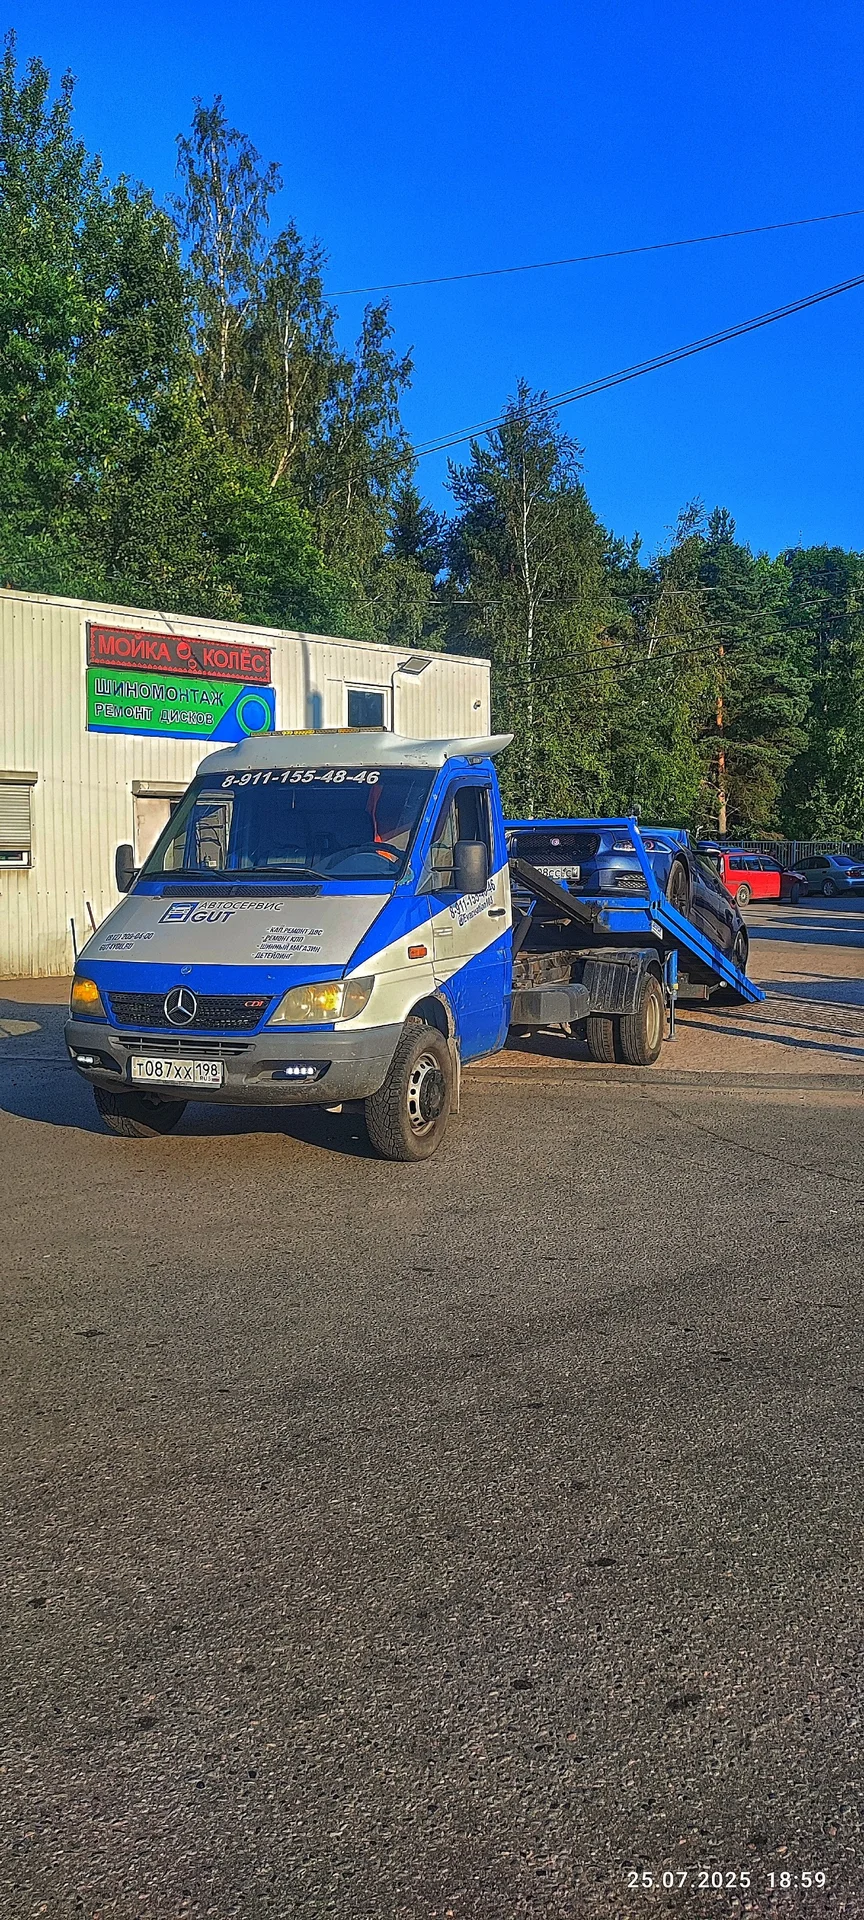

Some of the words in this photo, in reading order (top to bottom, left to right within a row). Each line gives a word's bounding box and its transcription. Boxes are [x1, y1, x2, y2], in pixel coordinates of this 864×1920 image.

[99, 634, 171, 662] МОЙКА
[203, 648, 265, 673] КОЛЁС
[94, 678, 224, 706] ШИНОМОНТАЖ
[94, 703, 153, 721] РЕМОНТ
[160, 709, 214, 725] ДИСКОВ
[221, 769, 380, 788] 8-911-155-48-46
[198, 901, 284, 911] АВТОСЕРВИС
[190, 911, 236, 923] GUT
[195, 1063, 218, 1076] 198
